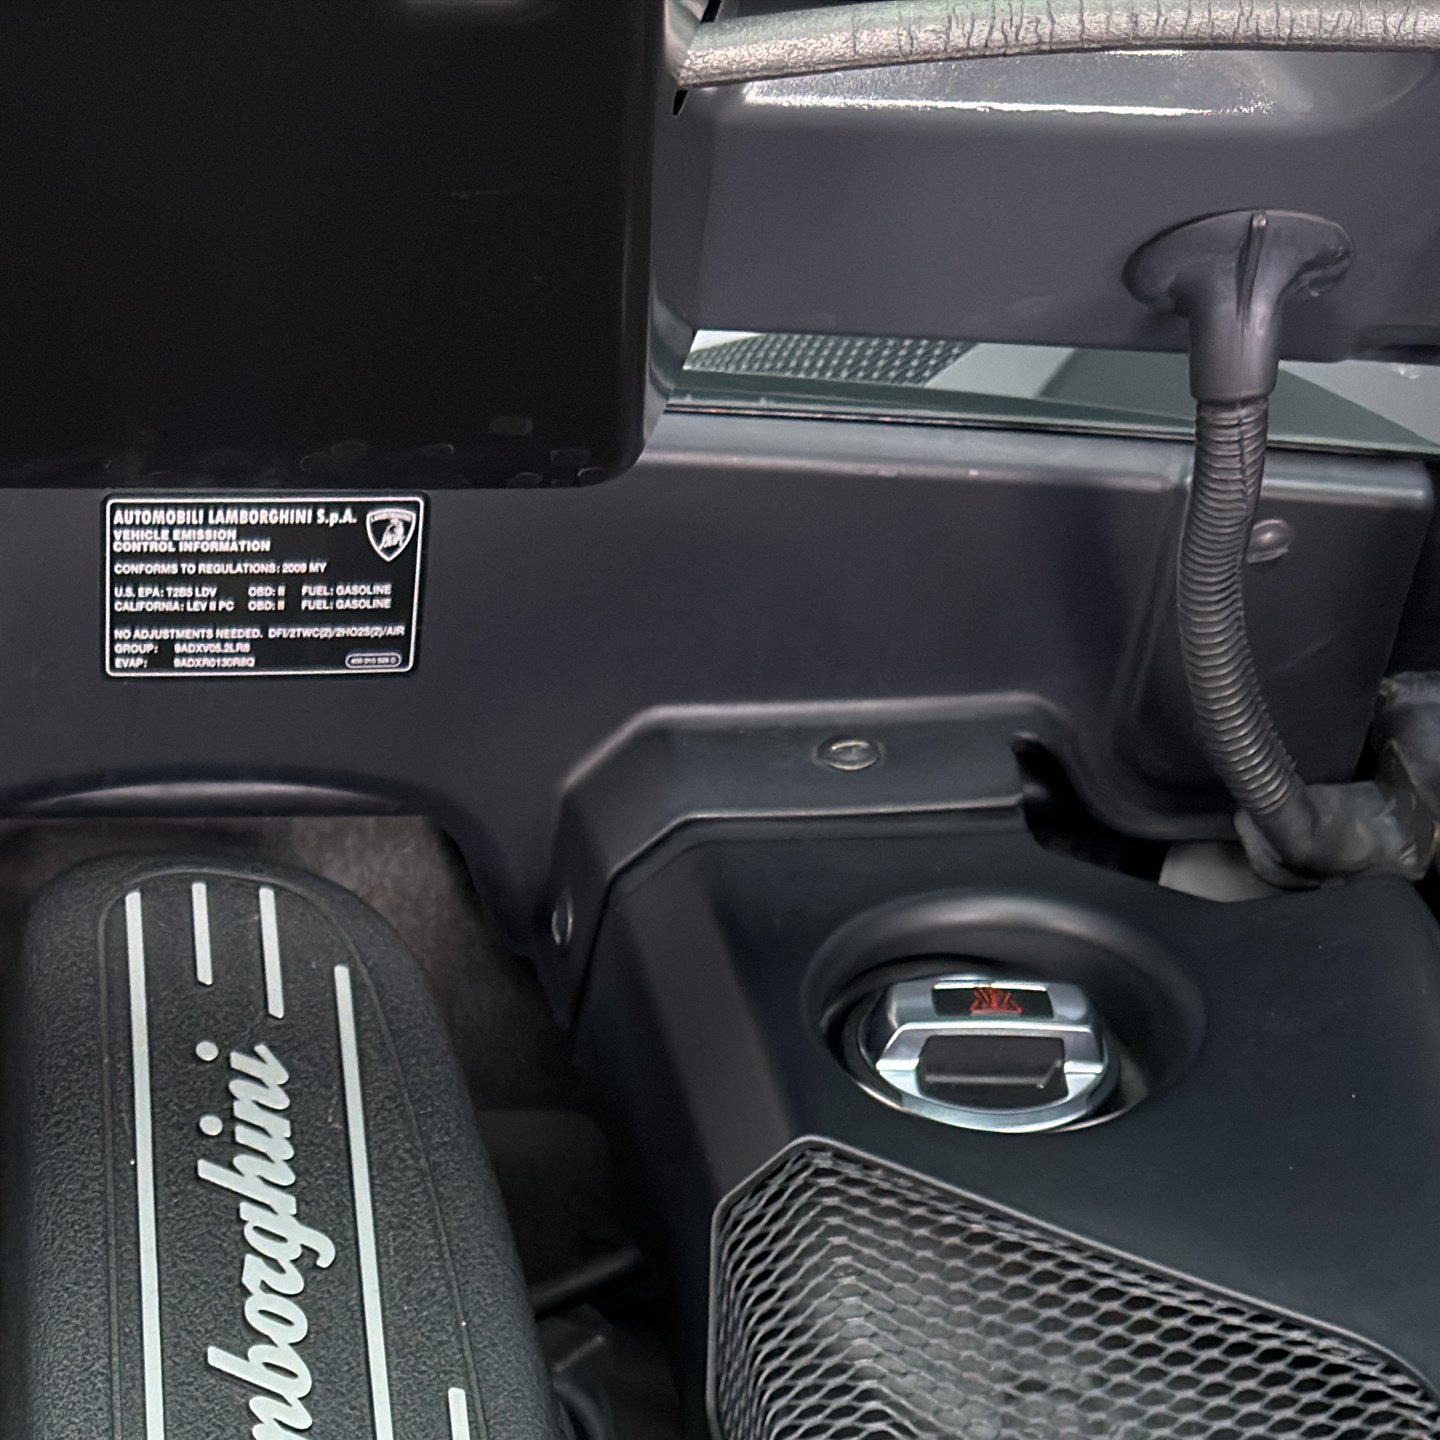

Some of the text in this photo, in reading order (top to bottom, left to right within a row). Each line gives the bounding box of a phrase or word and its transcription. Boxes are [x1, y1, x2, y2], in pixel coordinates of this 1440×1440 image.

[113, 509, 204, 525] AUTOMOBILI
[207, 508, 313, 525] LAMBORGHINI
[316, 507, 358, 528] S.p.A.
[113, 528, 237, 541] VEHICLE EMISSION
[113, 540, 271, 553] CONTROL INFORMATION
[113, 563, 179, 575] CONFORMS
[180, 563, 196, 574] TO
[197, 562, 281, 575] REGULATIONS:
[308, 561, 328, 574] MY
[113, 586, 136, 598] U.S.
[137, 586, 165, 598] EPA:
[195, 586, 218, 598] LDV
[248, 585, 276, 598] OBD:
[301, 584, 334, 597] FUEL:
[335, 583, 392, 596] GASOLINE
[113, 600, 185, 612] CALIFORNIA:
[186, 600, 208, 612] LEV
[218, 600, 235, 612] PC
[248, 600, 276, 612] OBD:
[301, 598, 334, 611] FUEL:
[335, 598, 392, 610] GASOLINE
[113, 628, 132, 640] NO
[132, 627, 214, 640] ADJUSTMENTS
[215, 627, 264, 639] NEEDED.
[113, 642, 159, 655] GROUP:
[114, 657, 148, 669] EVAP:
